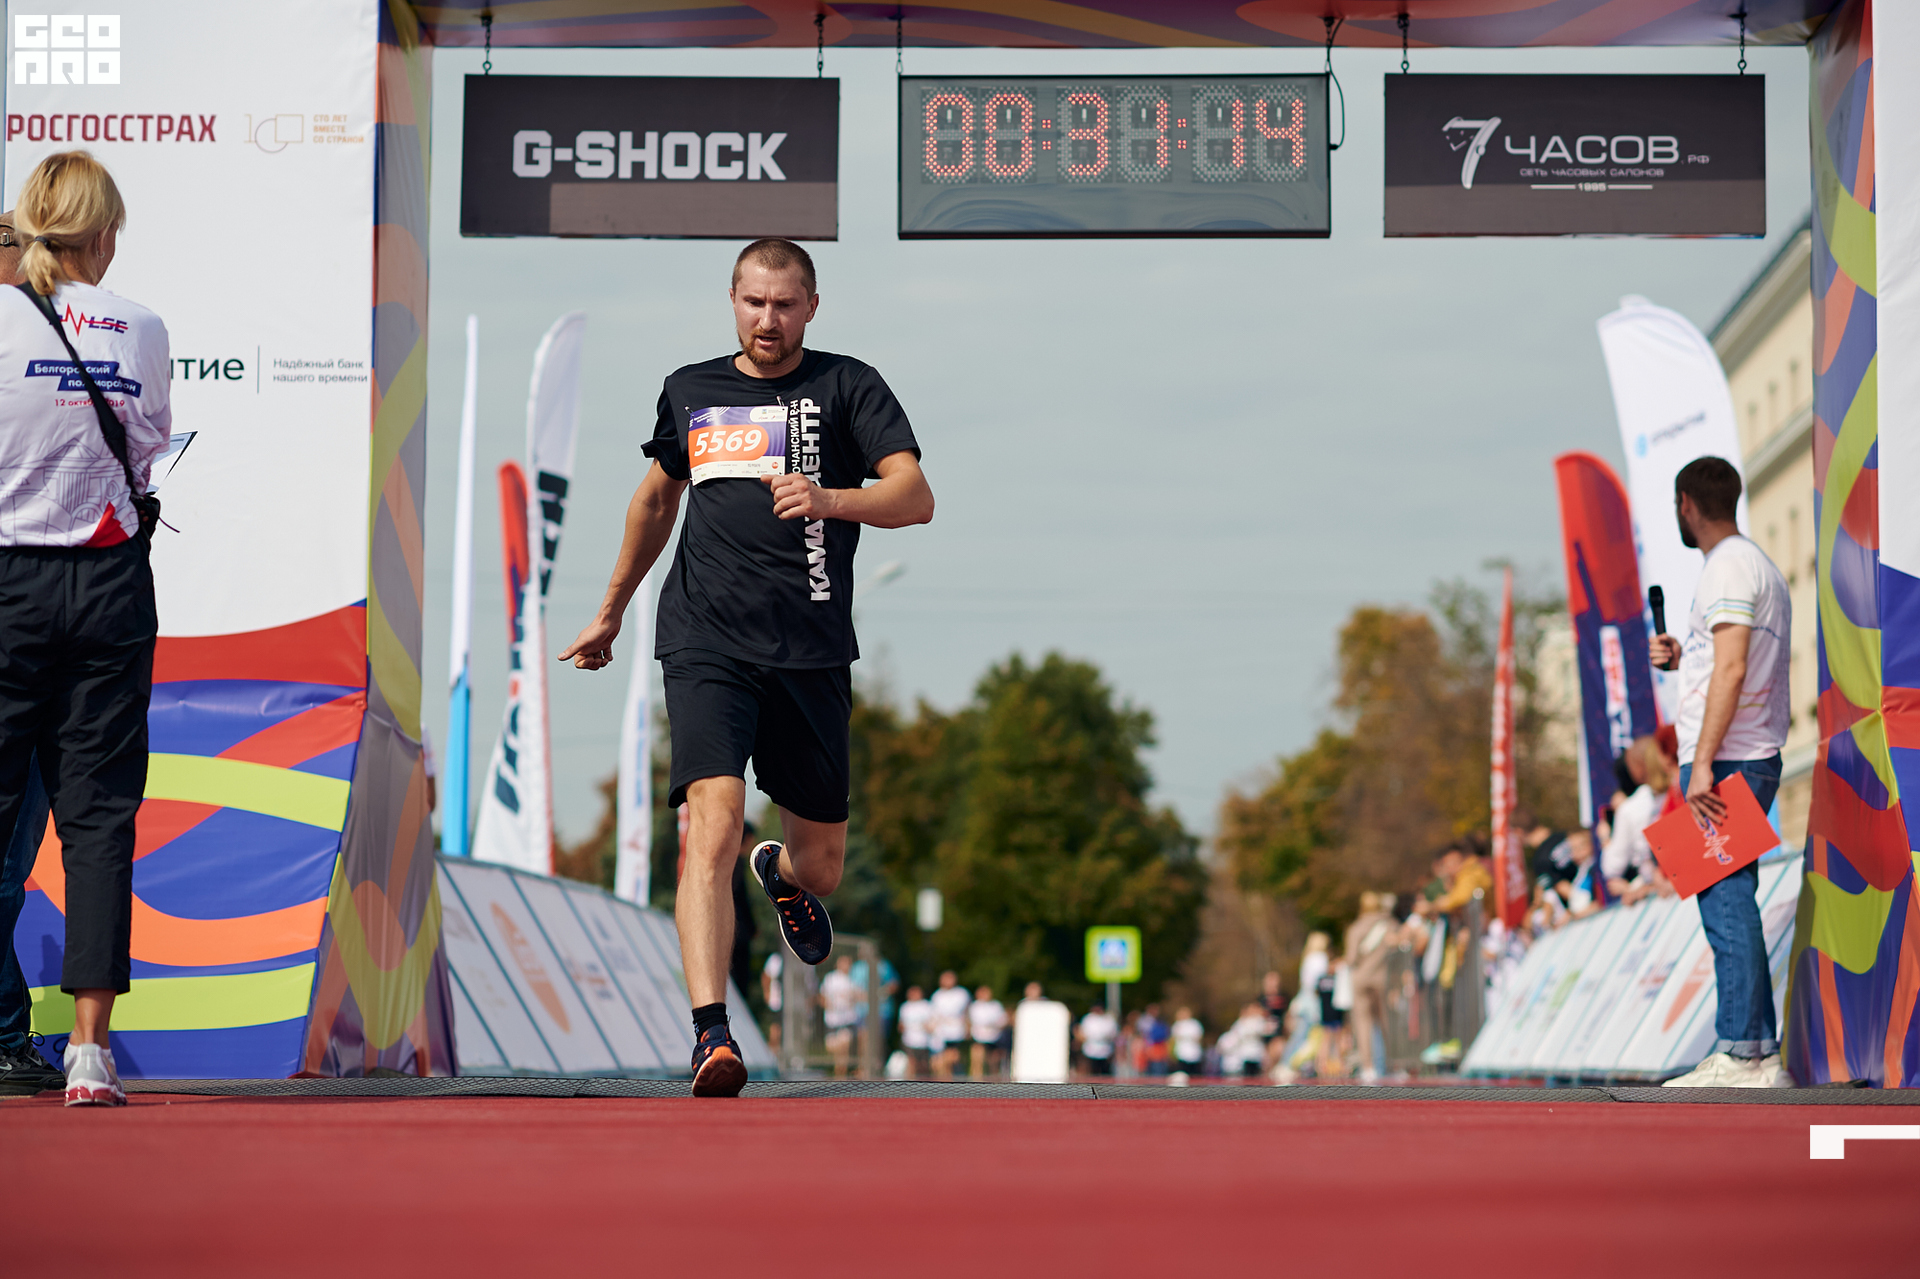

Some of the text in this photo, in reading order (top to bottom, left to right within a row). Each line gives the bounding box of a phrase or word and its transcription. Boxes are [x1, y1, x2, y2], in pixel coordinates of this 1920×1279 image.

[7, 114, 217, 142] РОСГОССТРАХ
[512, 130, 787, 181] G-SHOCK
[1520, 168, 1665, 178] СЕТЬ ЧАСОВЫХ САЛОНОВ
[34, 363, 111, 376] Белгороский
[273, 358, 364, 370] Надёжный банк
[273, 374, 368, 384] нашего времени
[55, 398, 66, 407] 12
[68, 398, 94, 407] октяб
[694, 429, 762, 457] 5569
[789, 417, 801, 474] ОЧАНСКИЙ
